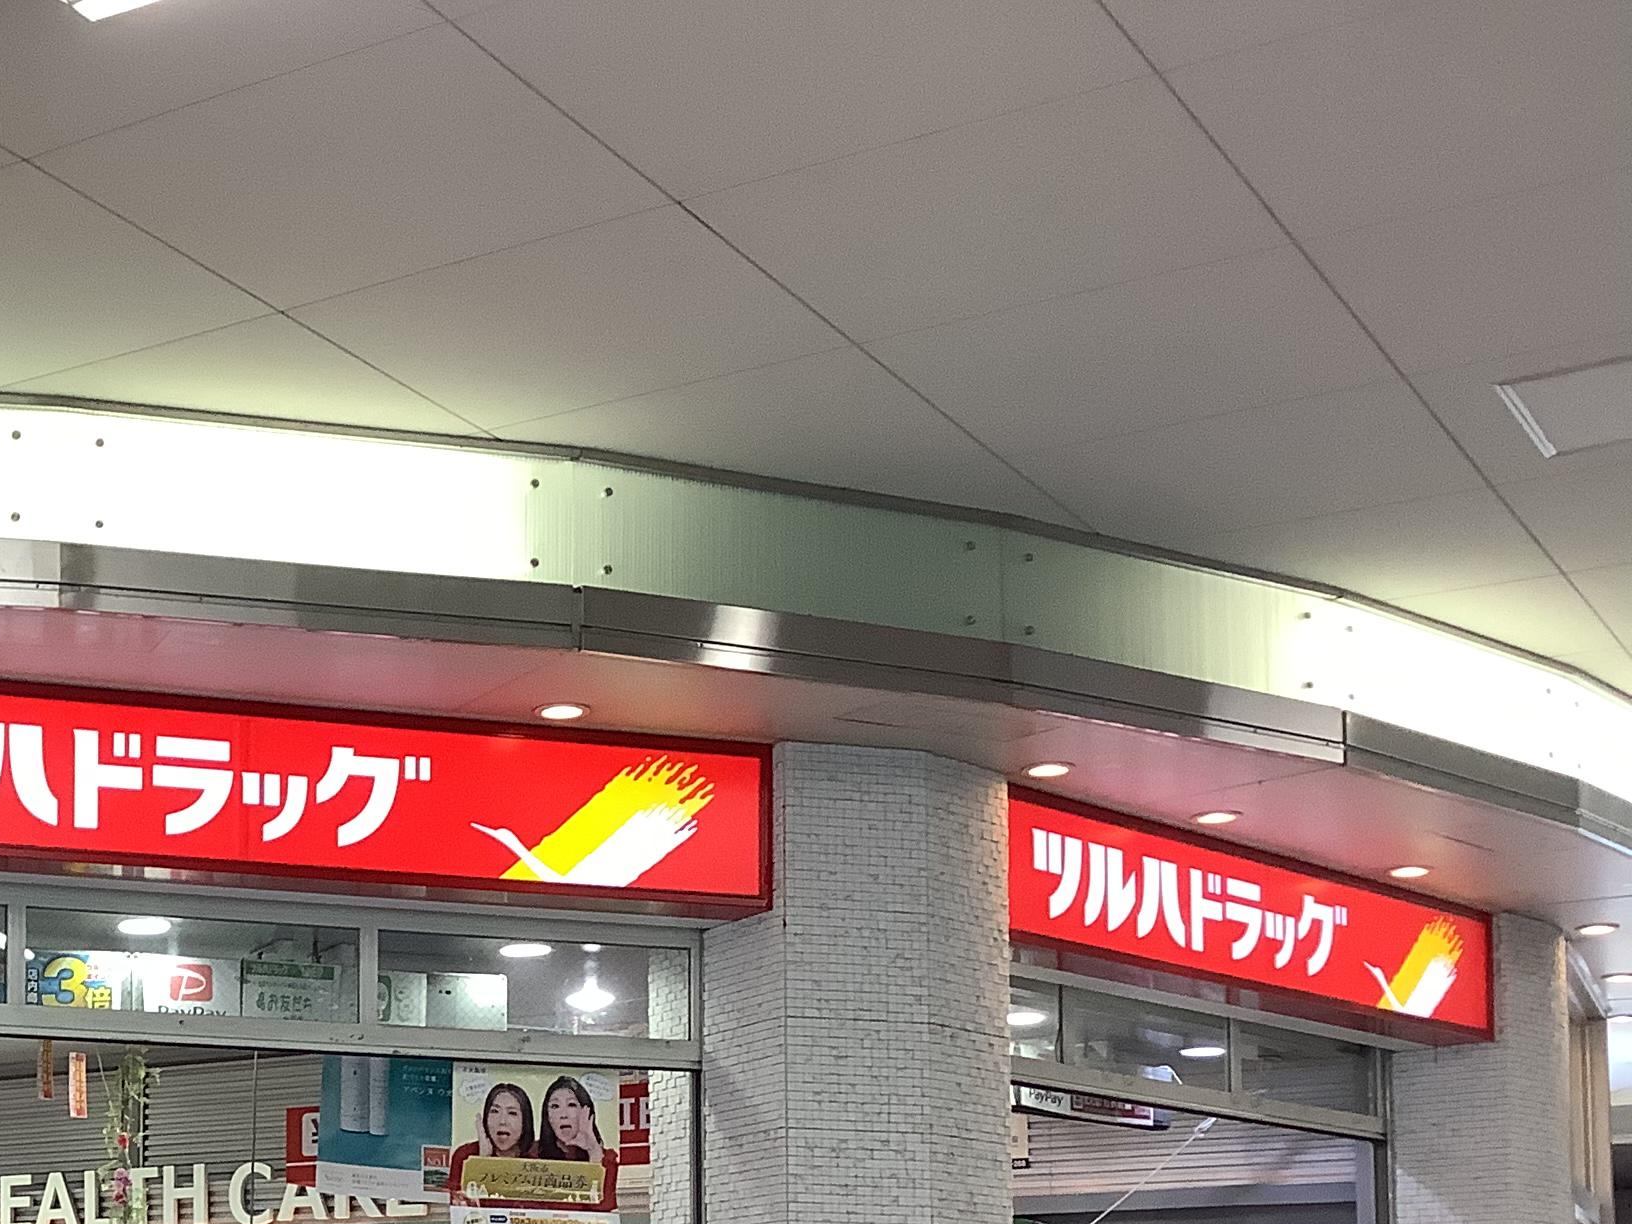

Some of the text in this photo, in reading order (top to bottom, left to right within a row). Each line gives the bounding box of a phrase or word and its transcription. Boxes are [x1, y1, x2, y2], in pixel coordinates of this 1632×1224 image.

[1032, 828, 1348, 975] ツルハドラッグ
